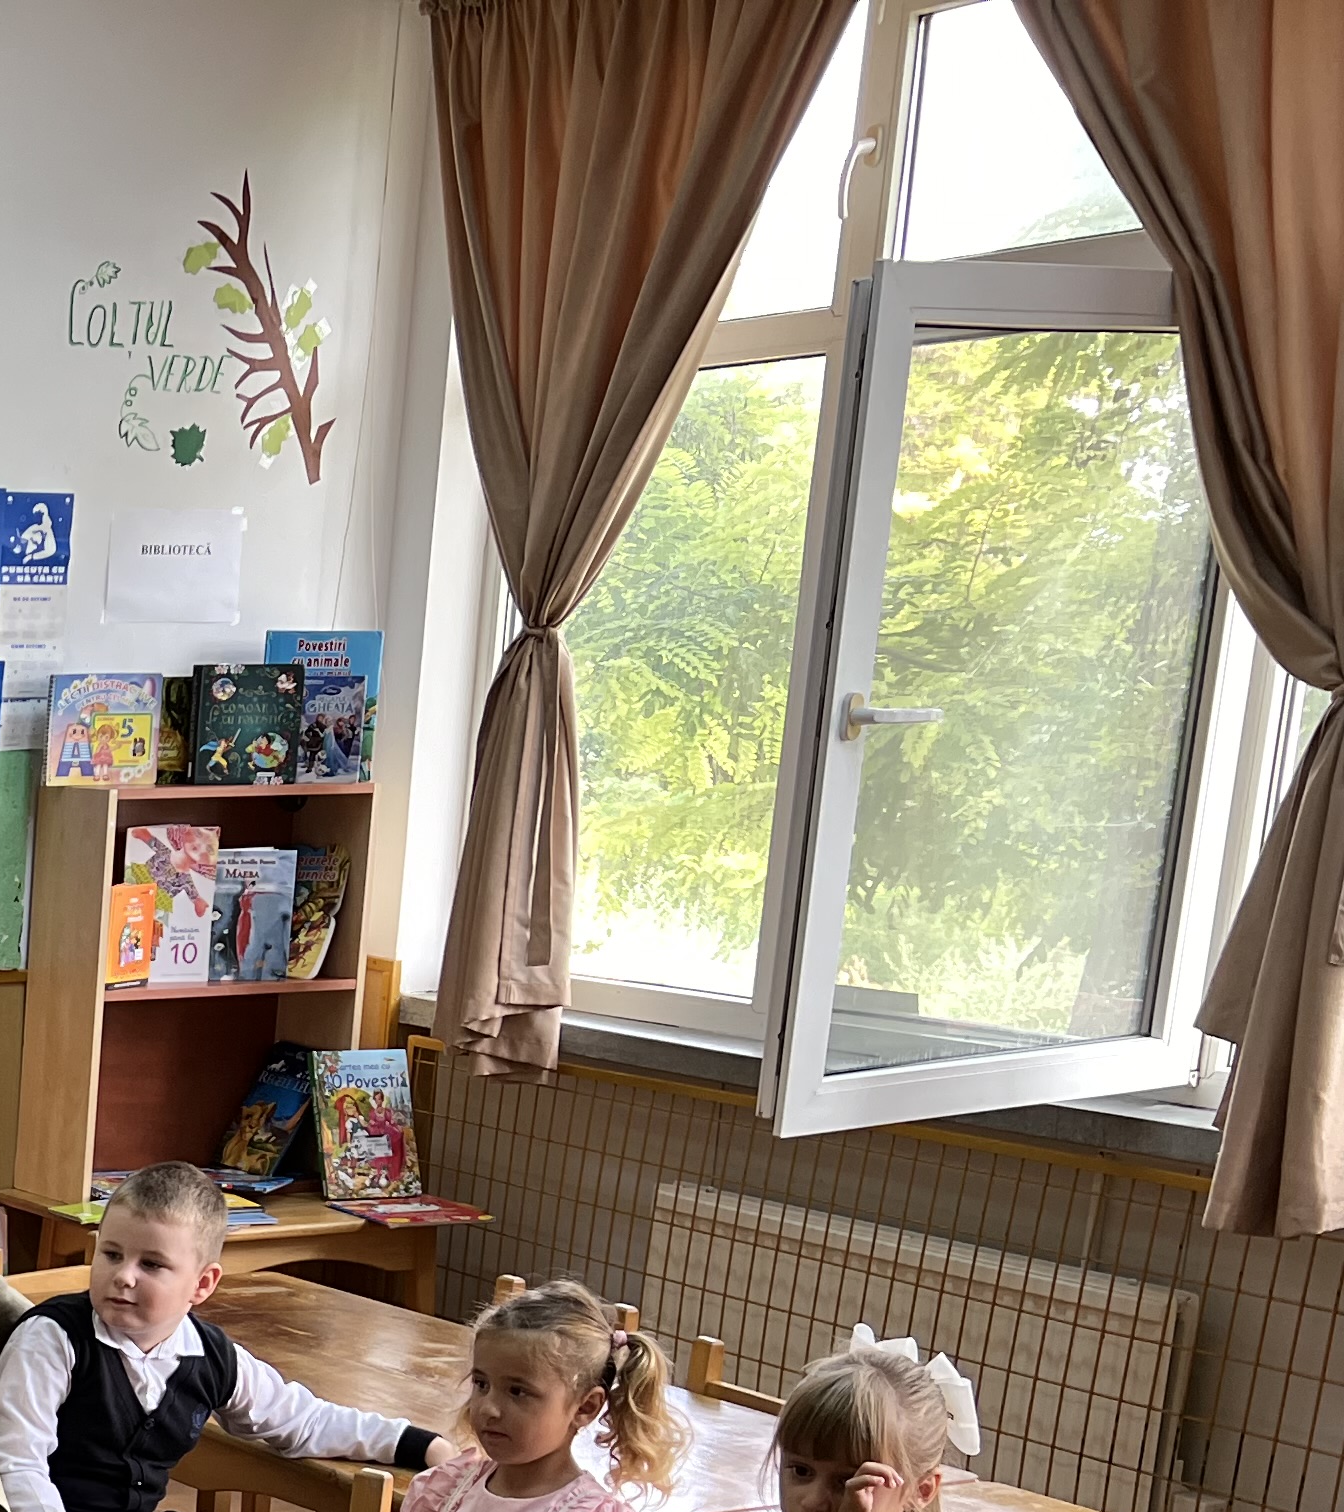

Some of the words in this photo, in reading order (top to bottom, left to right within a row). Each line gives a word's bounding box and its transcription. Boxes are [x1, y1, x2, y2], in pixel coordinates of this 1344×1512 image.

[148, 353, 232, 393] VERDE
[141, 542, 212, 556] BIBLIOTECĂ
[298, 639, 347, 652] Povestiri
[306, 656, 350, 668] animale
[297, 870, 336, 881] urnica
[171, 942, 198, 965] 10
